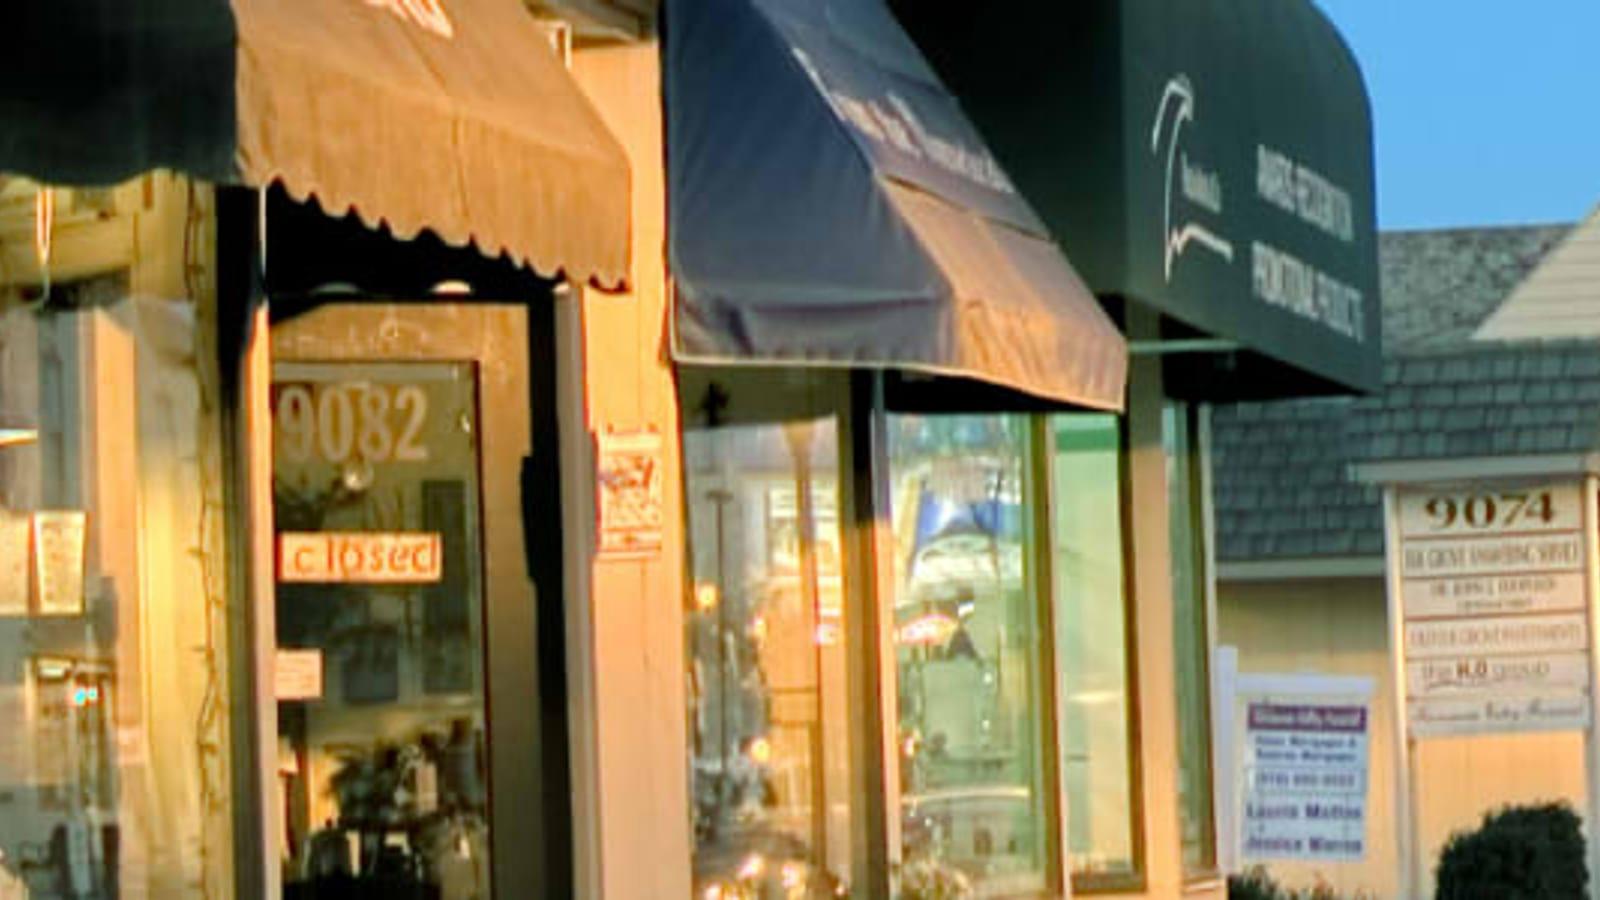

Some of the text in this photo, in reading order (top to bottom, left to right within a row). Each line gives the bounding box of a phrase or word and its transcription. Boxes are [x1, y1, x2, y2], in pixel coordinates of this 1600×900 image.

[279, 384, 428, 462] 9082
[1425, 492, 1554, 530] 9074
[294, 534, 438, 577] closed
